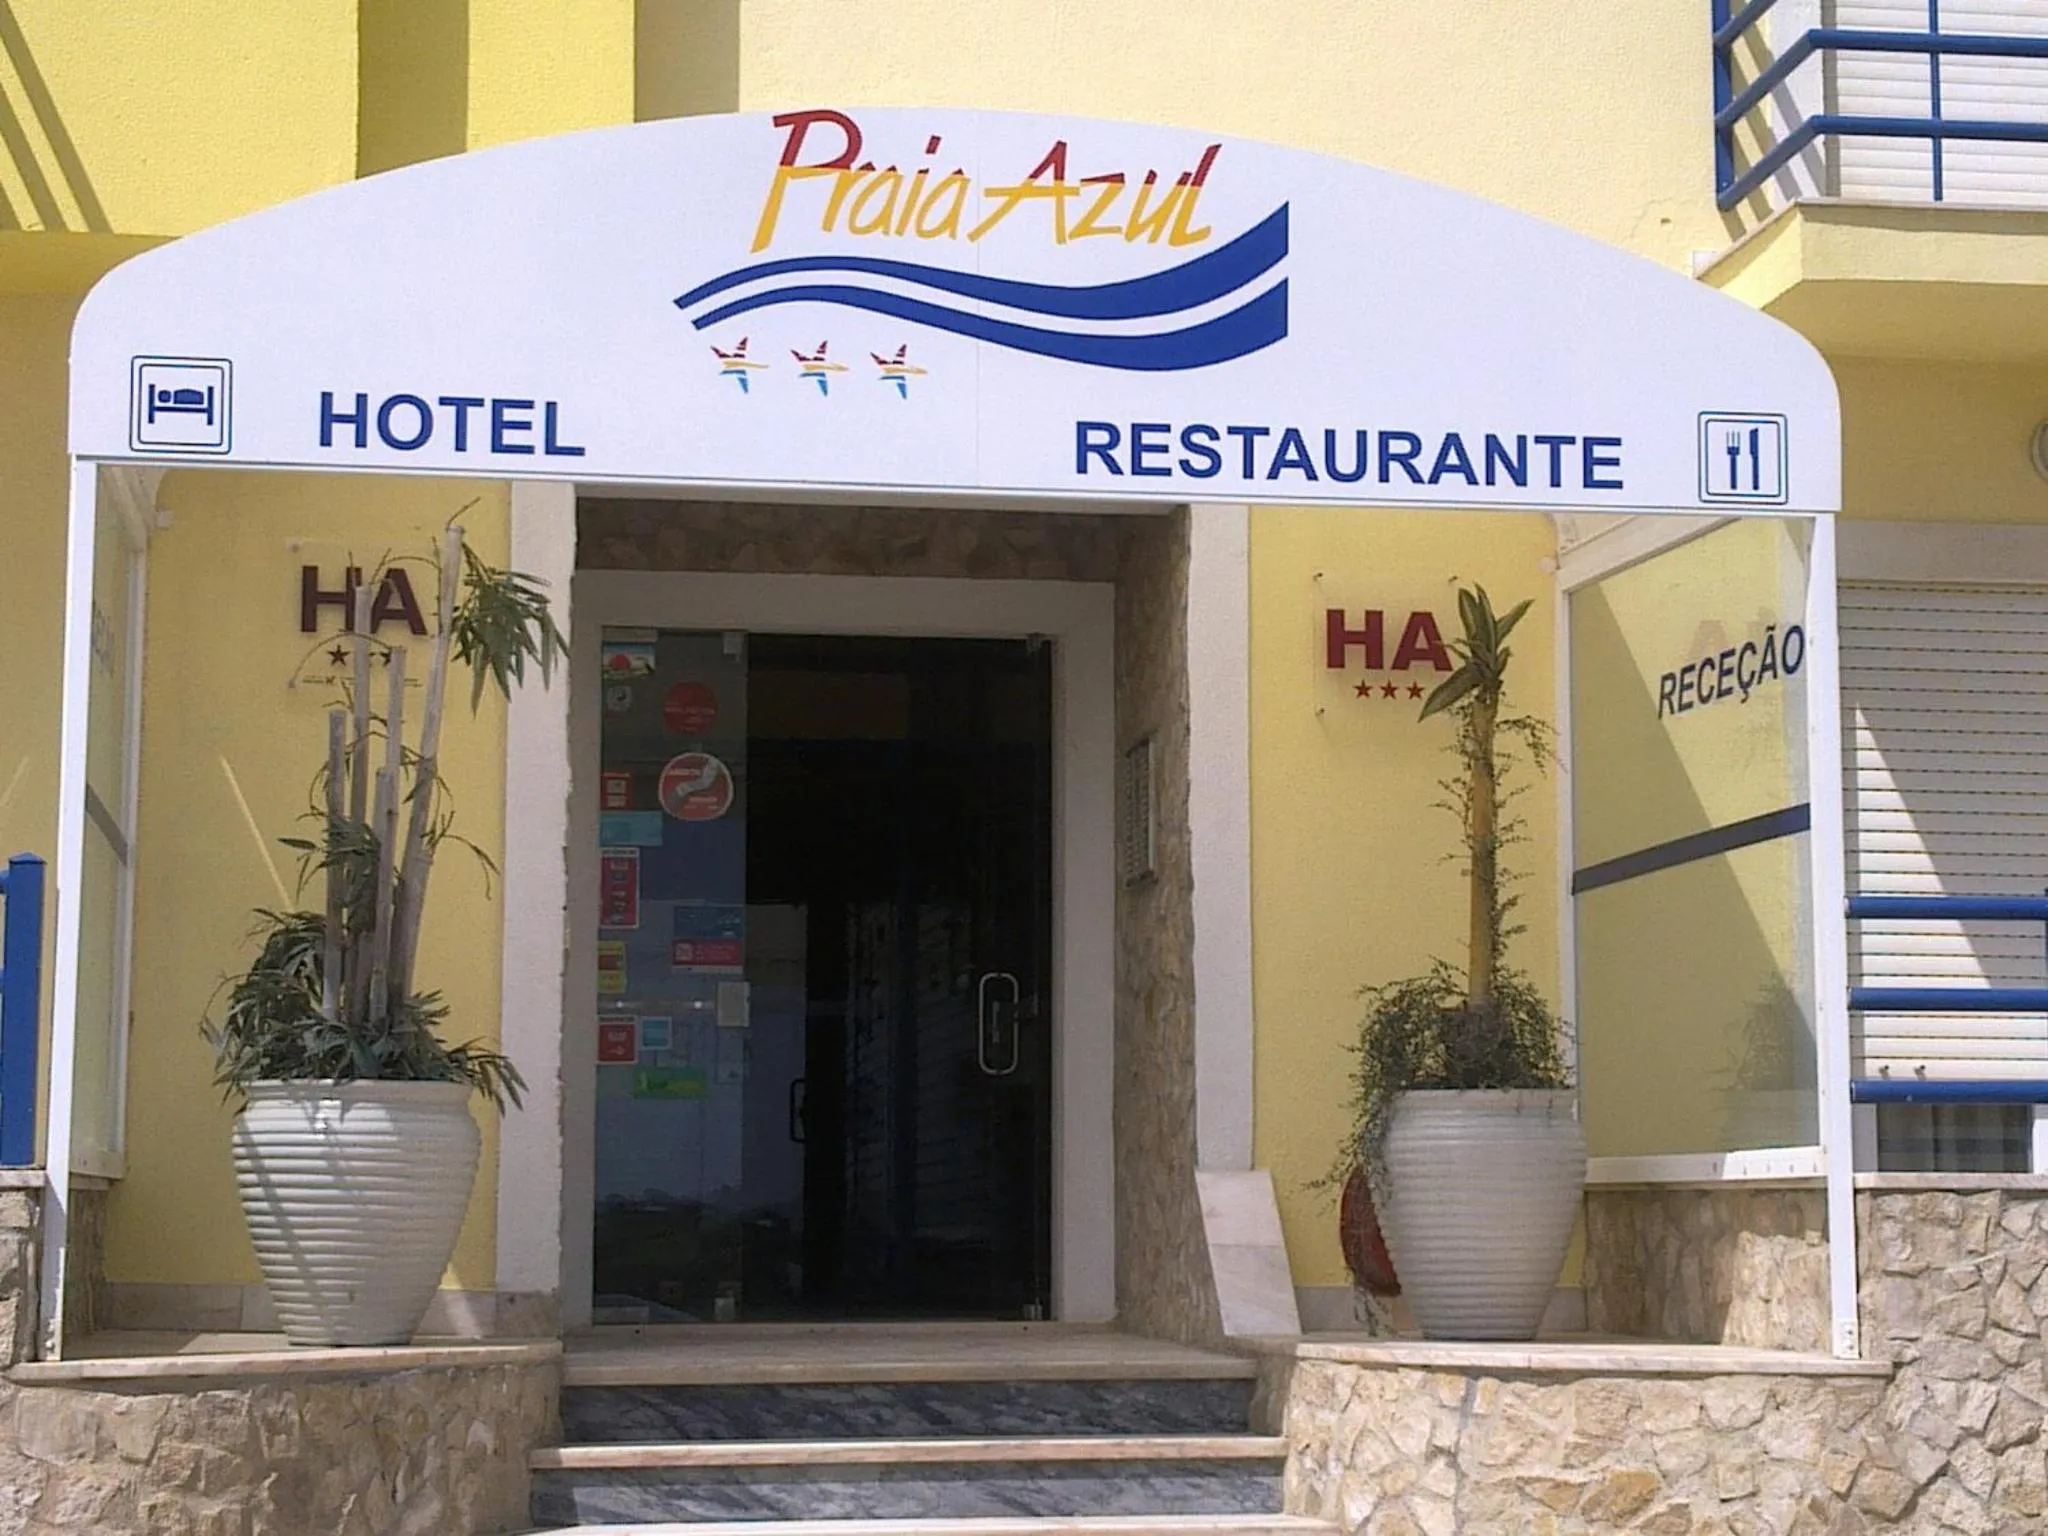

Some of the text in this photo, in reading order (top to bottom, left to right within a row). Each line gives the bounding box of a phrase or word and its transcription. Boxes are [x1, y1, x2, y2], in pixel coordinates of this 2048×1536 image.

[750, 110, 1223, 254] Praia Azul
[319, 391, 586, 457] HOTEL
[1075, 421, 1624, 490] RESTAURANTE
[301, 565, 428, 636] HA
[1326, 608, 1453, 672] HA
[1658, 623, 1805, 720] RECEÇÃO
